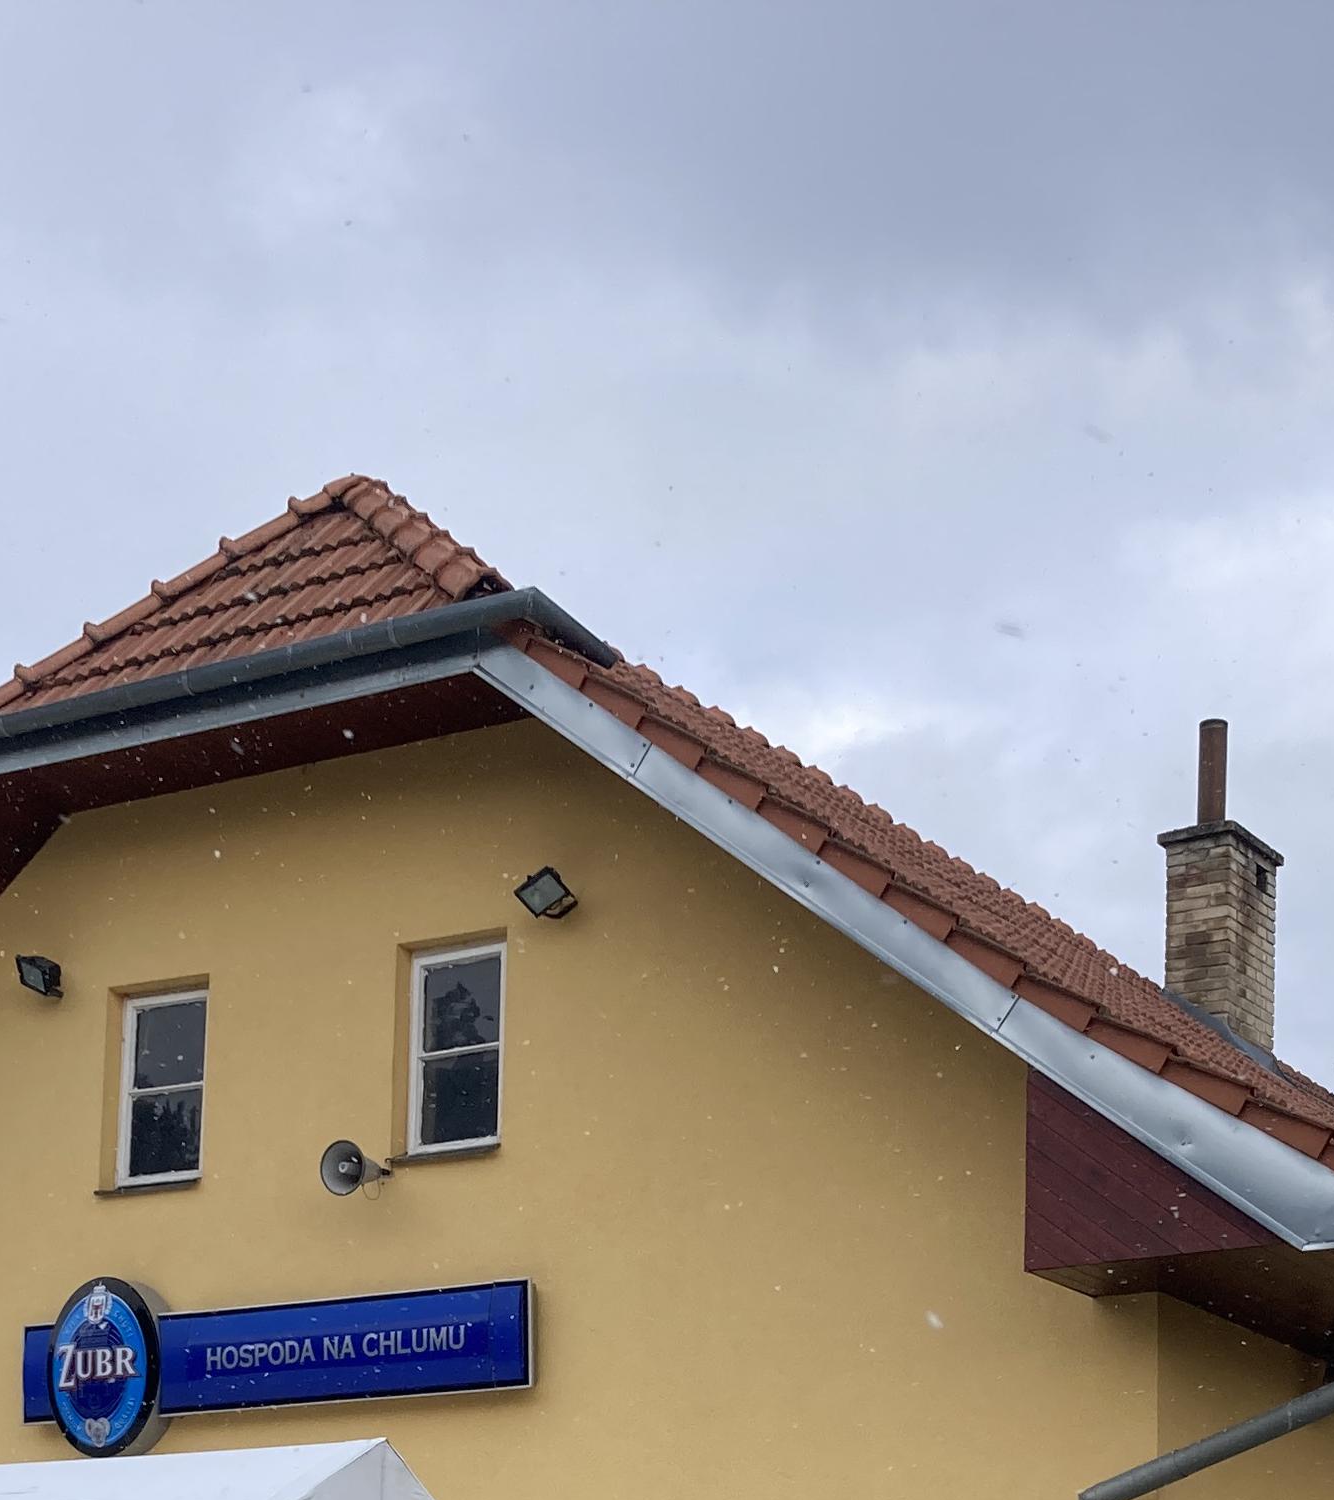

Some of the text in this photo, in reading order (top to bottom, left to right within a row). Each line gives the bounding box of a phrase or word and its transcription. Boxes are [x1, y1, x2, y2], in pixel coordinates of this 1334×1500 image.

[57, 1343, 137, 1390] ZUBR
[206, 1325, 466, 1371] HOSPODA NA CHLUMU
